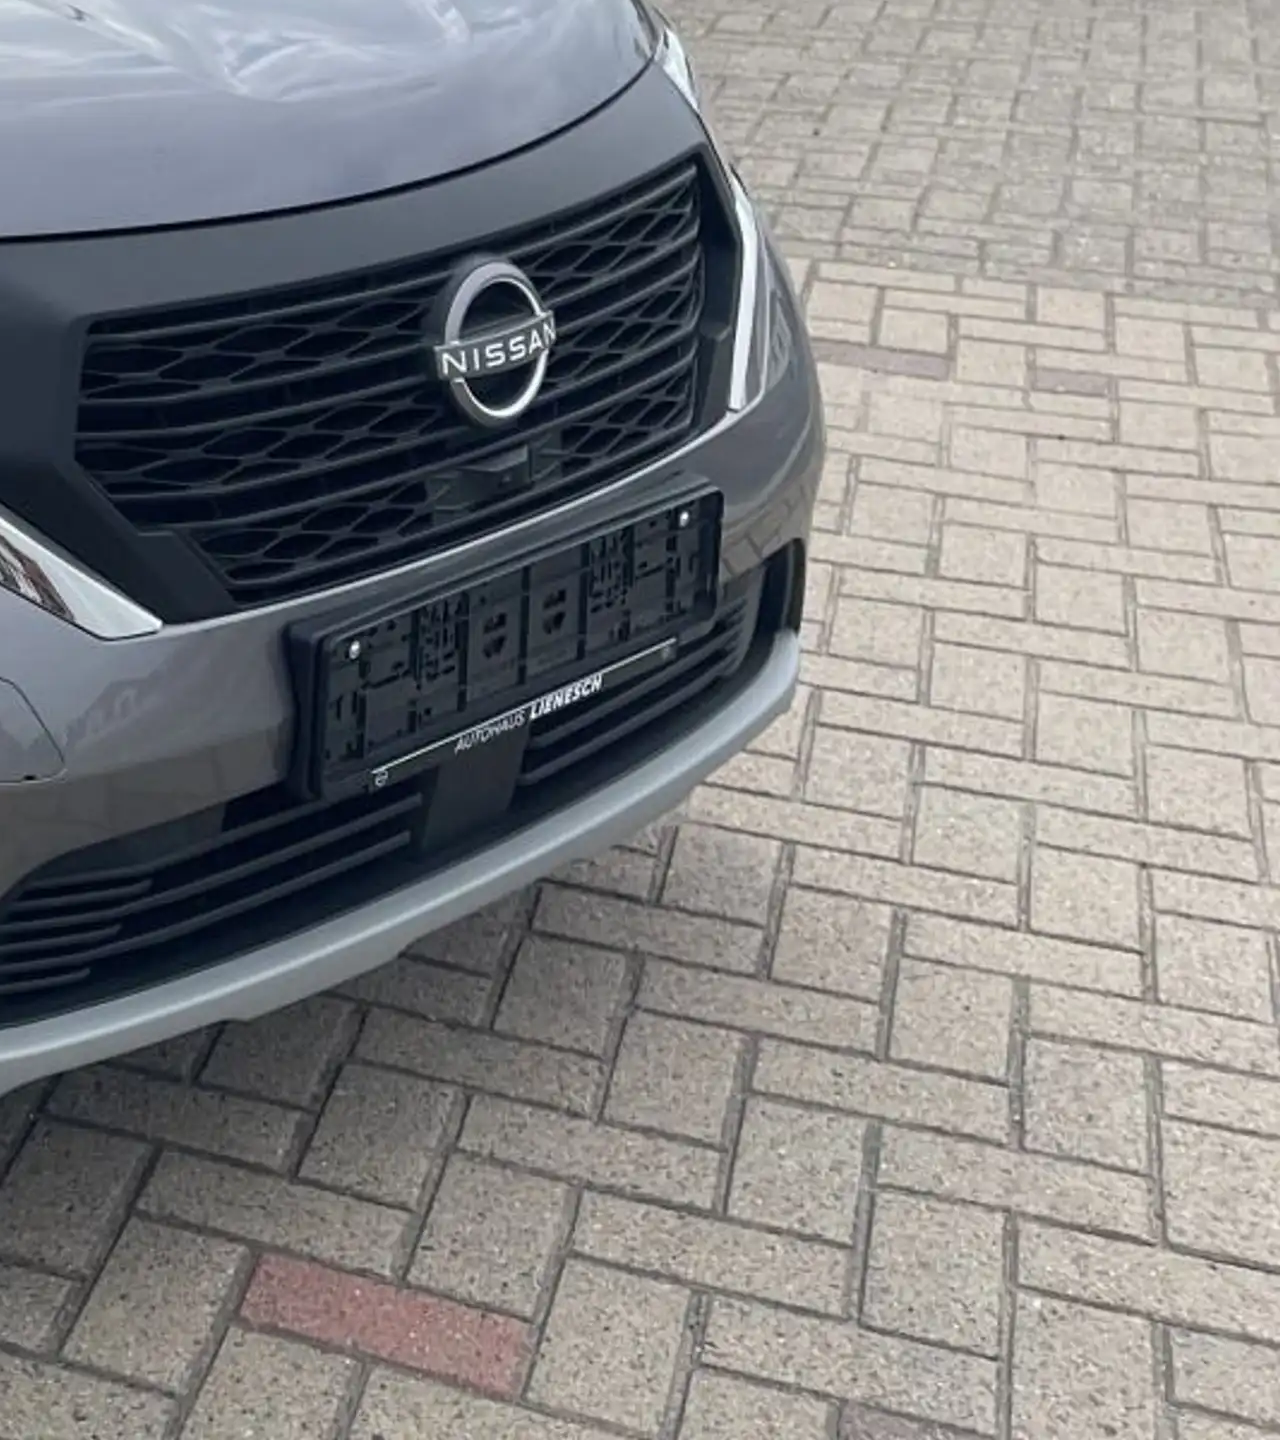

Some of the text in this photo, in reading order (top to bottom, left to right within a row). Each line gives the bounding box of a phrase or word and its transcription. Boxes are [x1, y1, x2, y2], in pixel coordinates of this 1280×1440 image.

[442, 316, 556, 376] NISSAN
[454, 672, 603, 755] AUTOHAUS LIENESCH
